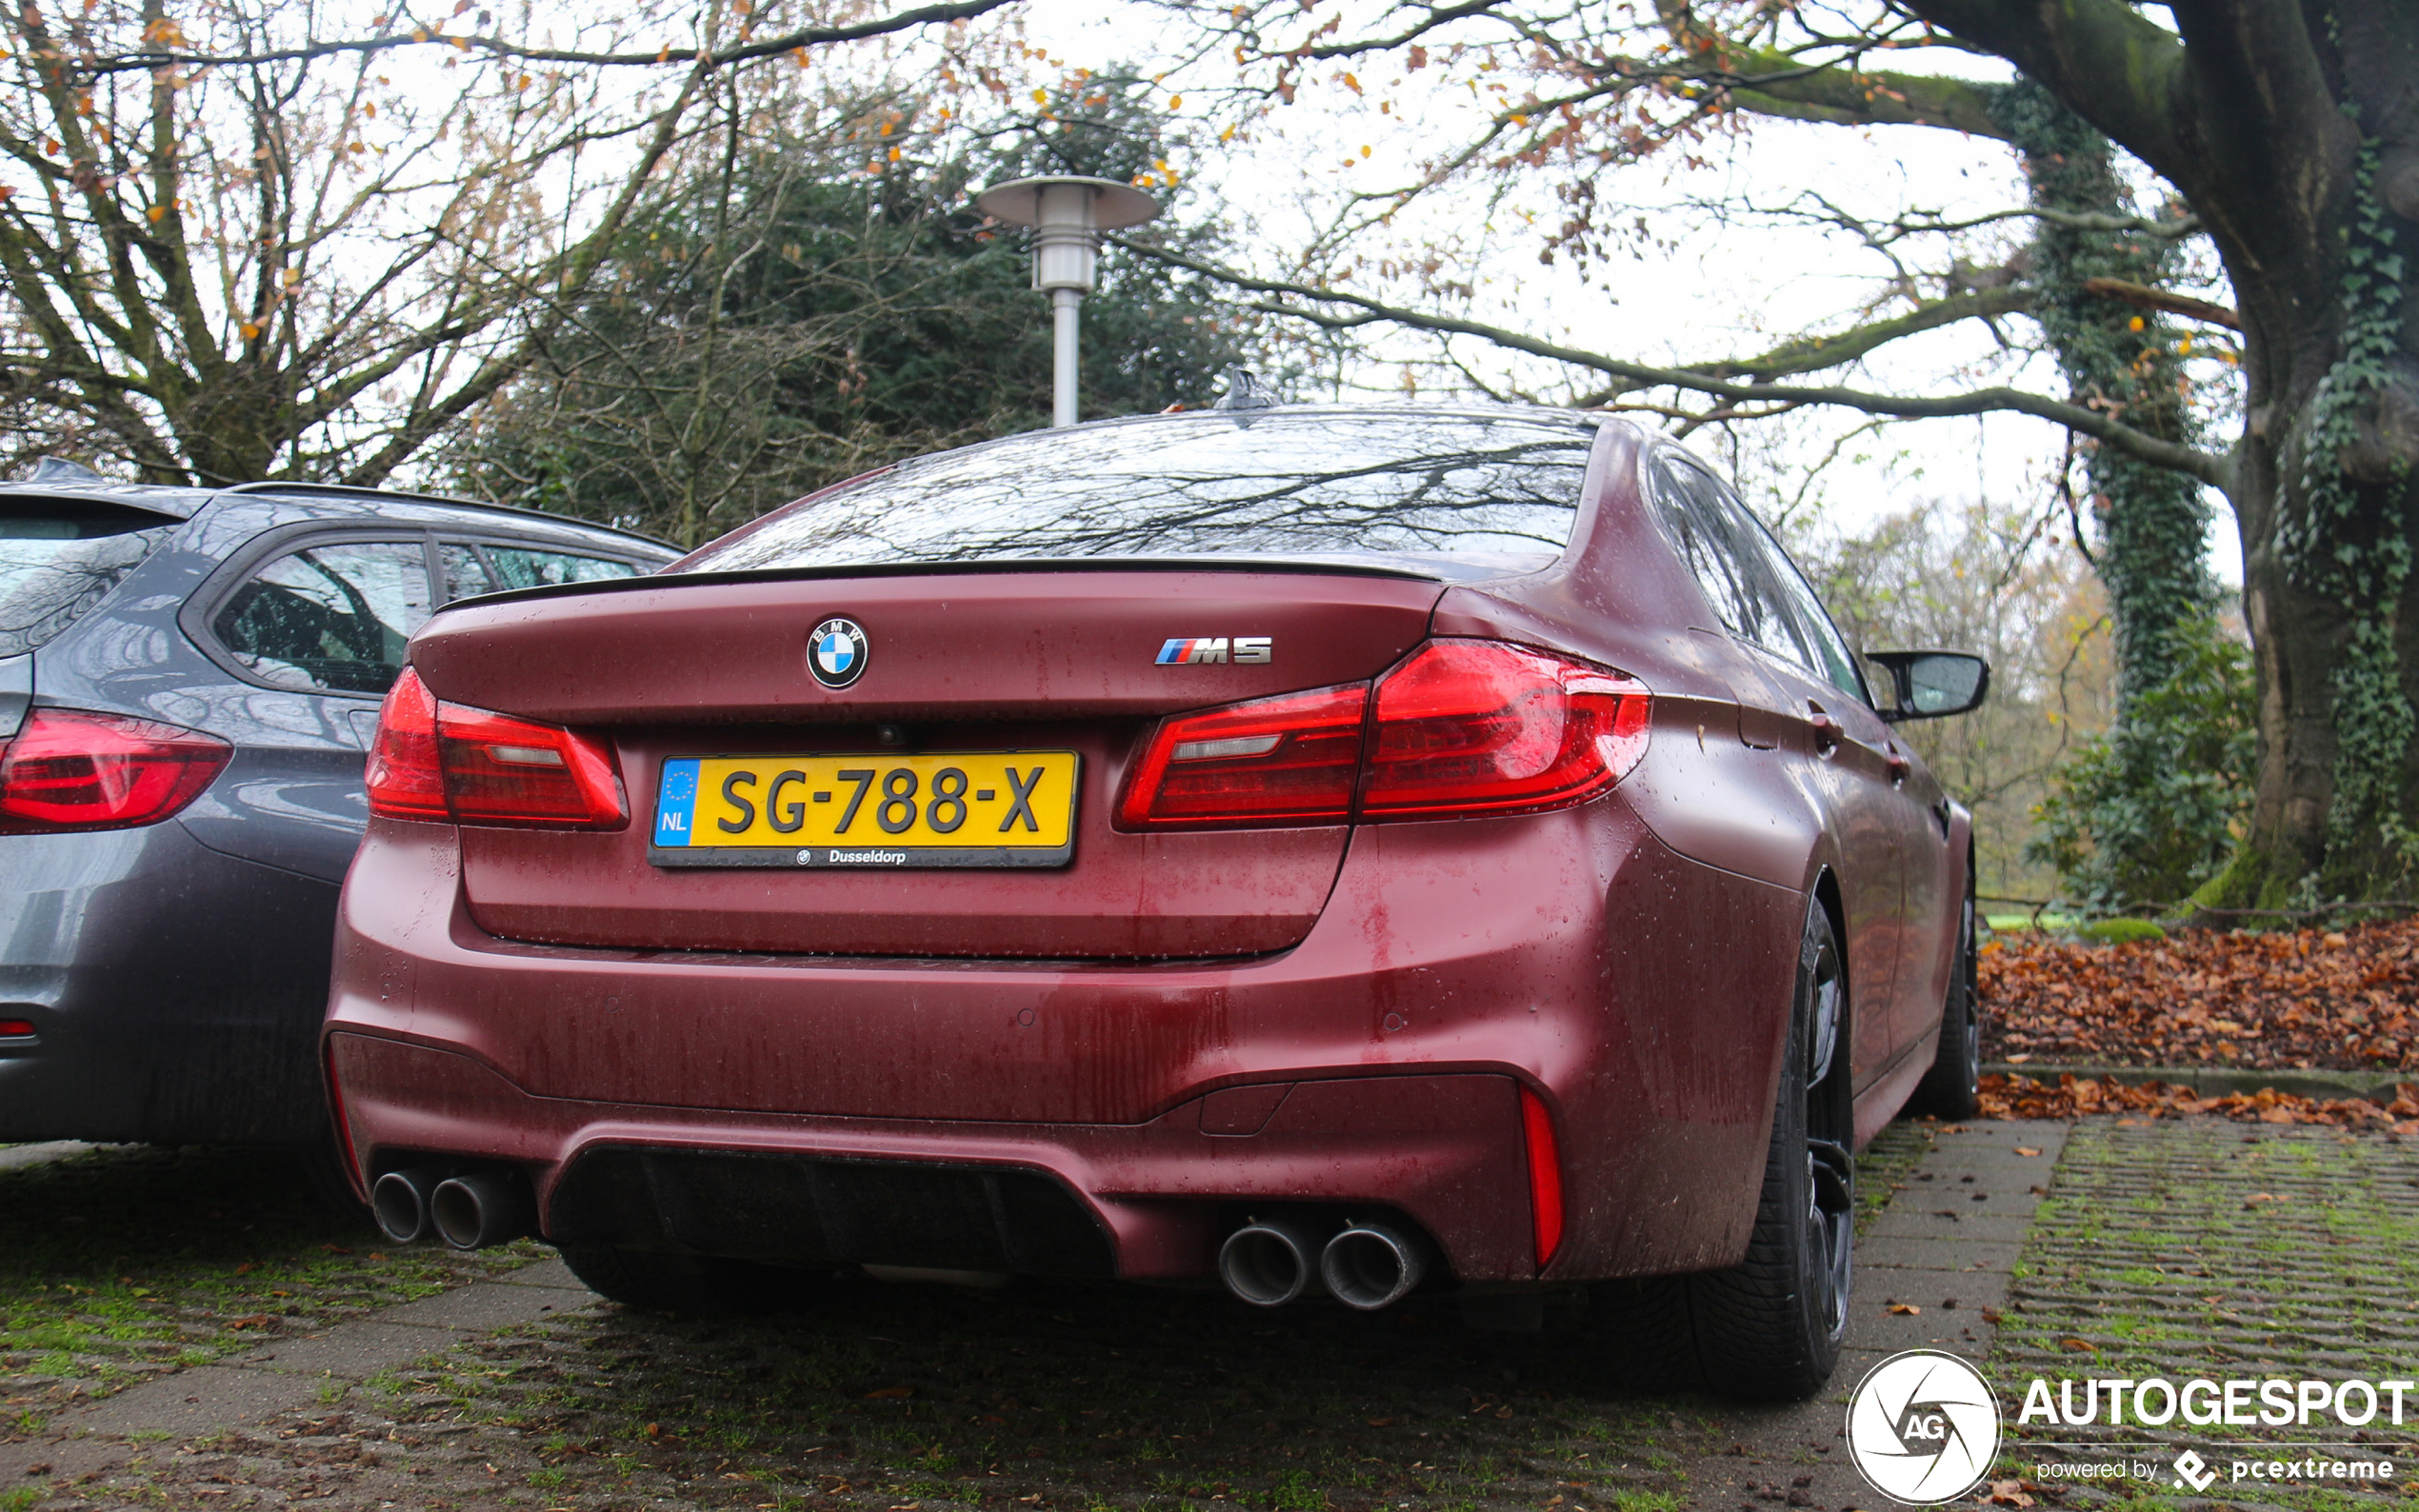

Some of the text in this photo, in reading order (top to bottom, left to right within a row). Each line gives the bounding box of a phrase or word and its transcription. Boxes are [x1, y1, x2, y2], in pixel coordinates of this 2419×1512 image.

[812, 622, 862, 643] BMW
[1186, 637, 1271, 664] M5
[718, 766, 1045, 834] SG-788-X
[662, 812, 687, 831] NL
[829, 849, 906, 865] Dusseldorp
